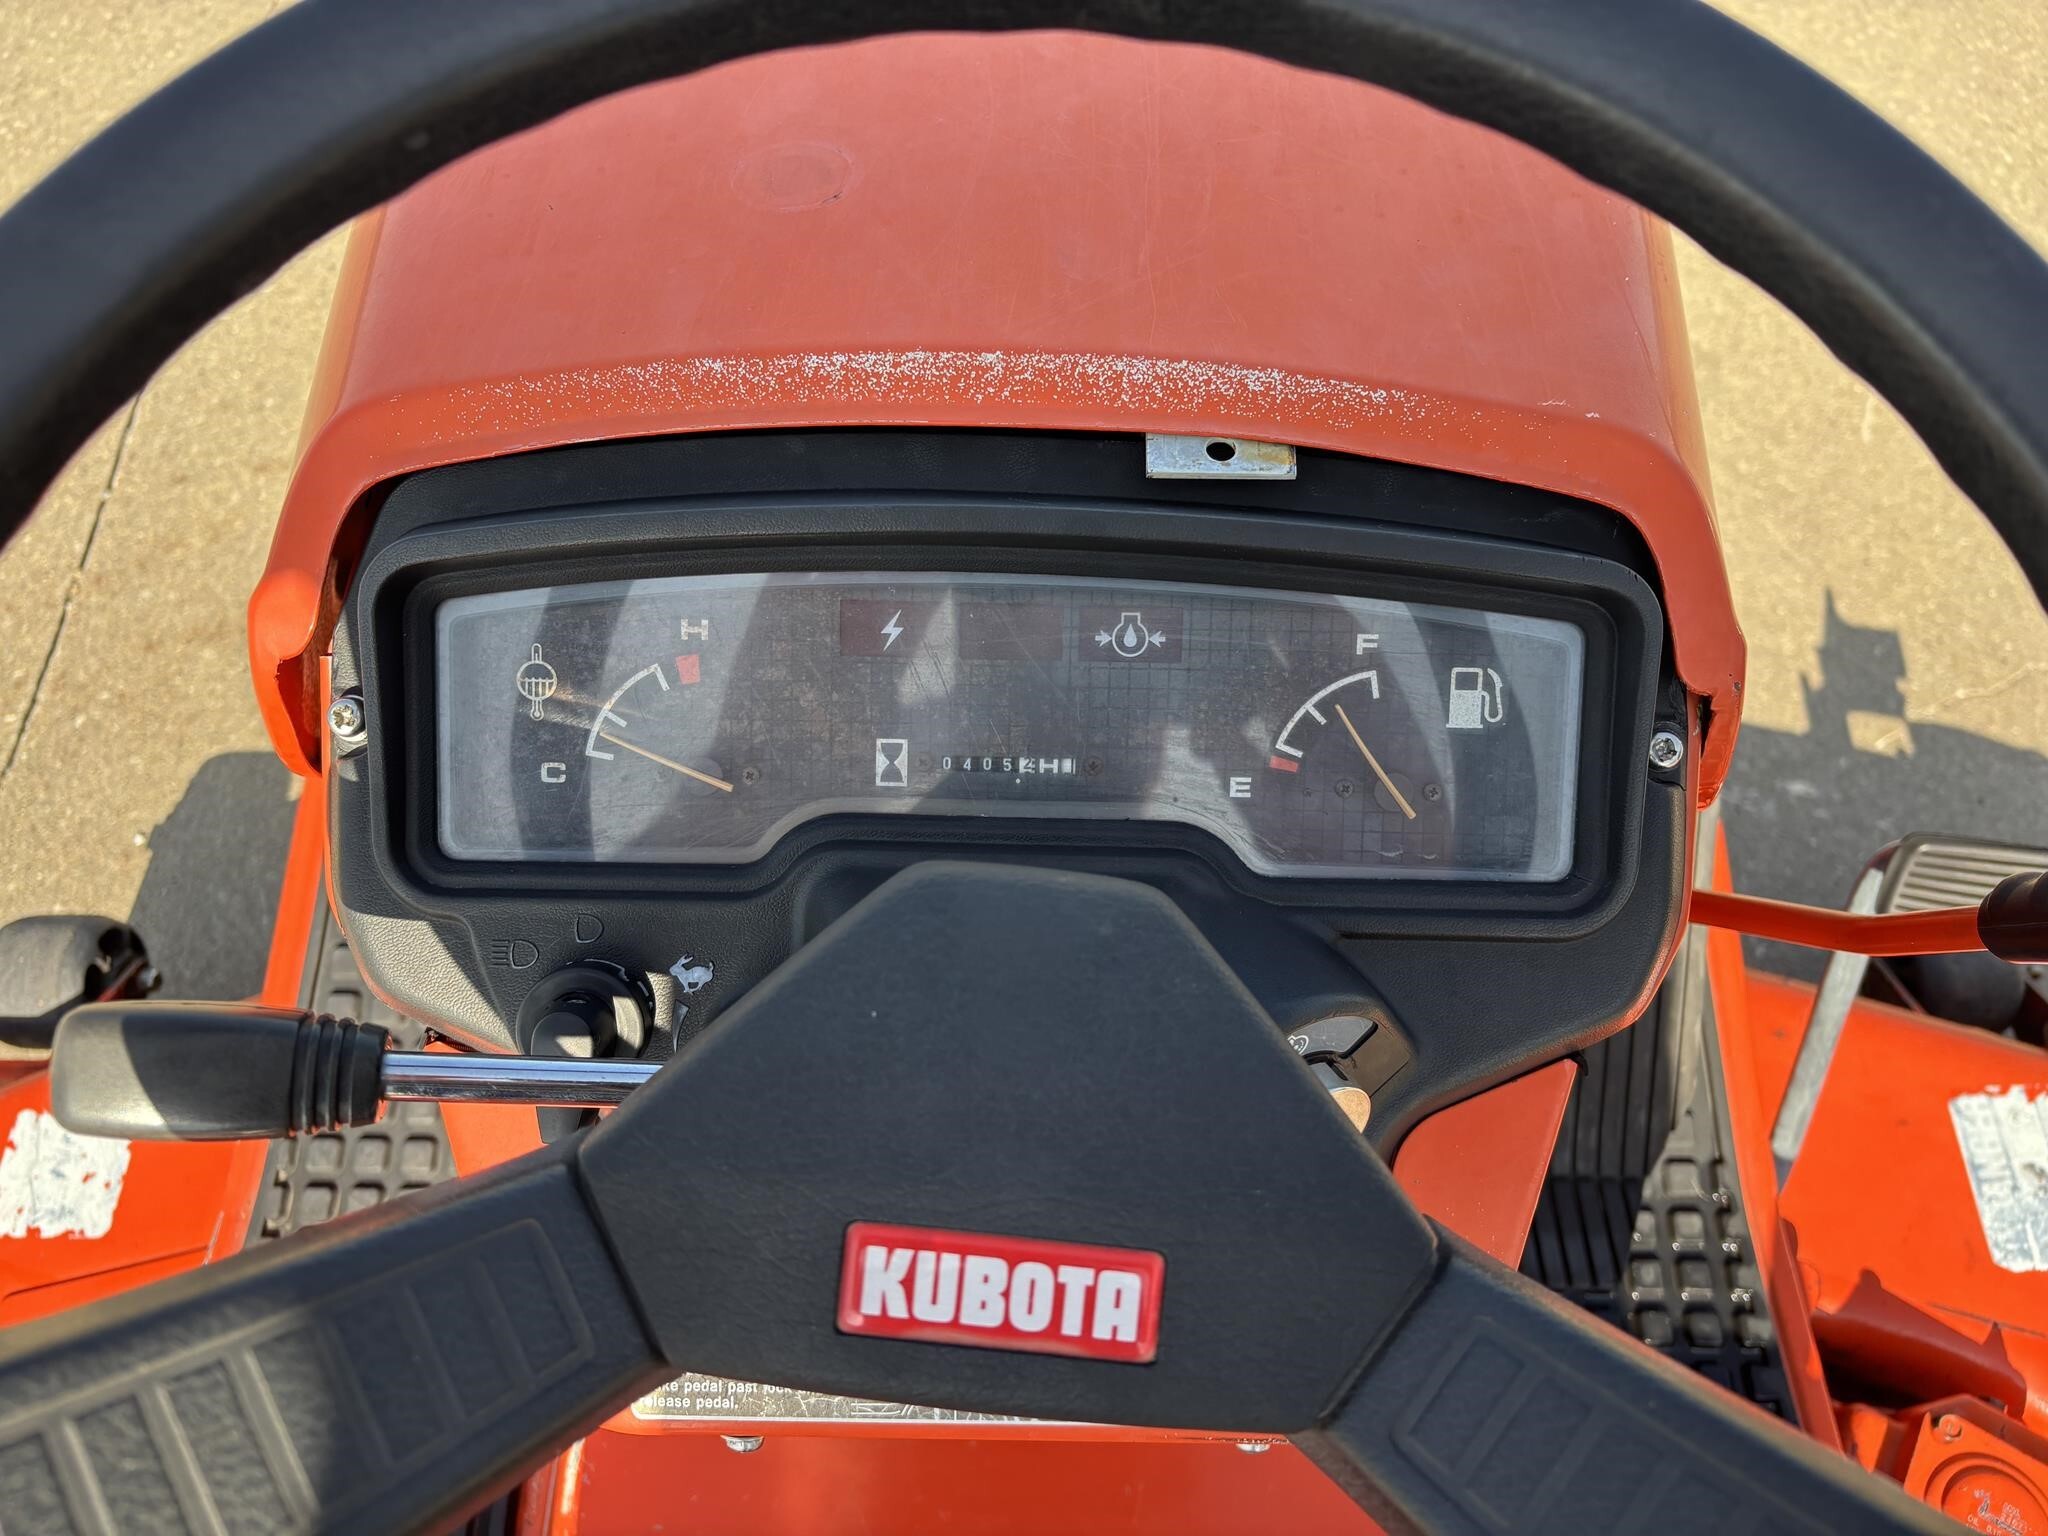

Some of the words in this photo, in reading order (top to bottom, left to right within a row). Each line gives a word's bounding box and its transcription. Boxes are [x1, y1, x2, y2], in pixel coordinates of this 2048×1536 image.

[681, 618, 709, 641] H
[1356, 633, 1380, 655] F
[540, 762, 567, 783] C
[1229, 776, 1252, 798] E
[860, 1245, 1142, 1342] KUBOTA
[684, 1379, 722, 1395] pedal
[727, 1381, 758, 1396] past
[696, 1395, 739, 1411] pedal.
